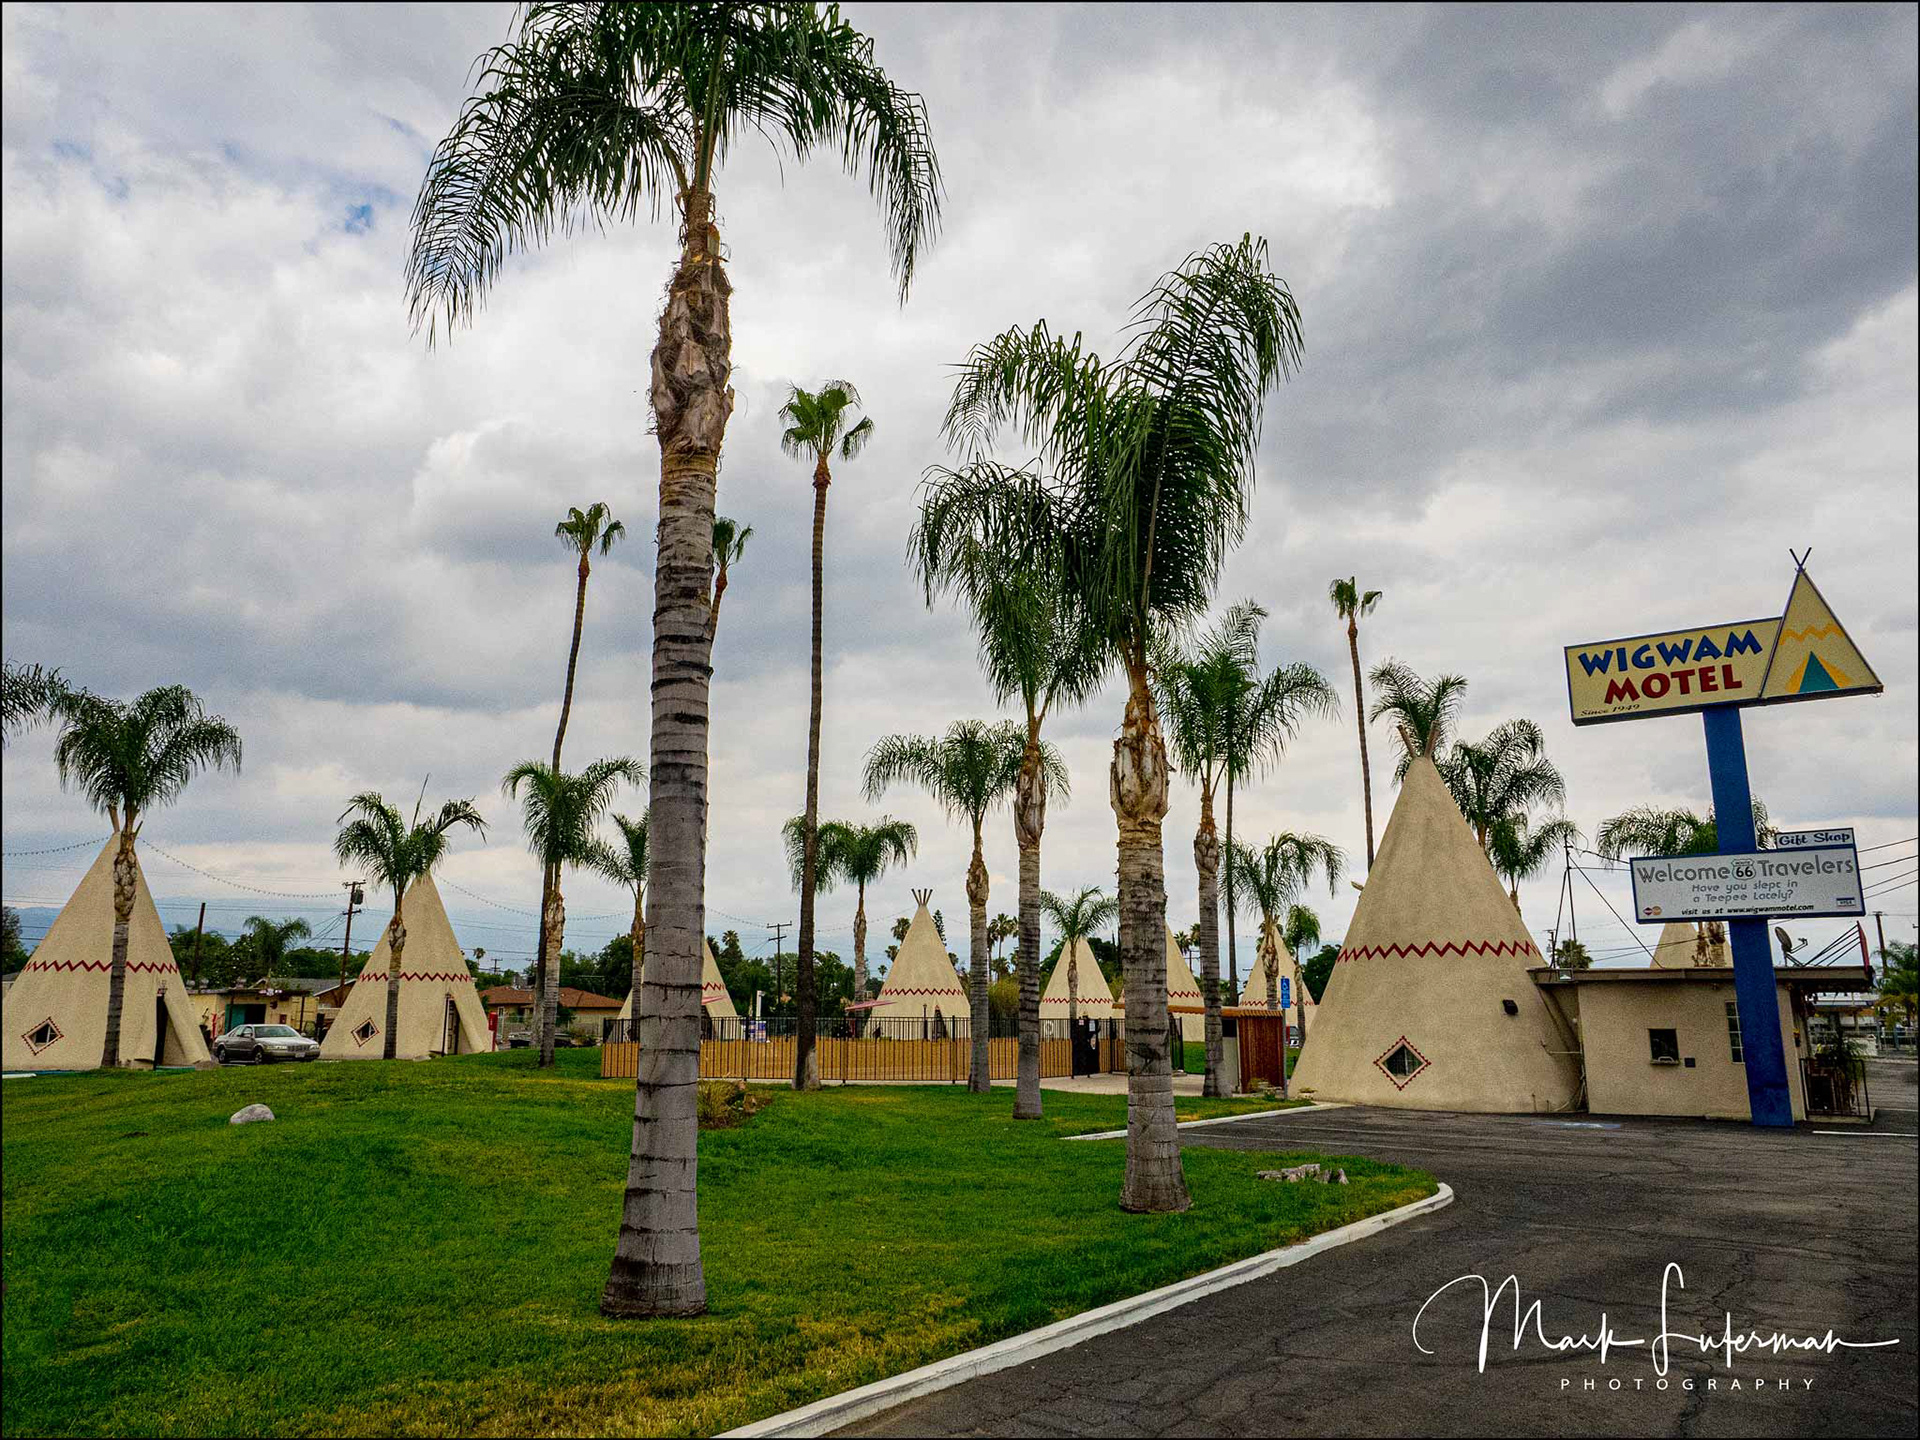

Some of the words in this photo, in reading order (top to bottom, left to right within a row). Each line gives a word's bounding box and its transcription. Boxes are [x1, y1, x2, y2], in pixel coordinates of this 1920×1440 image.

[1578, 630, 1762, 677] WIGWAM
[1604, 664, 1742, 705] MOTEL
[1612, 704, 1640, 712] 1949
[1779, 834, 1807, 846] Gift
[1814, 832, 1850, 843] Shop
[1637, 863, 1730, 883] Welcome
[1736, 866, 1753, 877] 66
[1758, 855, 1854, 877] Travelers
[1692, 884, 1719, 892] Have
[1726, 883, 1747, 894] you
[1753, 880, 1781, 892] slept
[1787, 880, 1798, 888] in
[1705, 893, 1747, 904] Teepee
[1753, 889, 1793, 902] Lately?
[1727, 904, 1814, 915] www.wigwammotel.com
